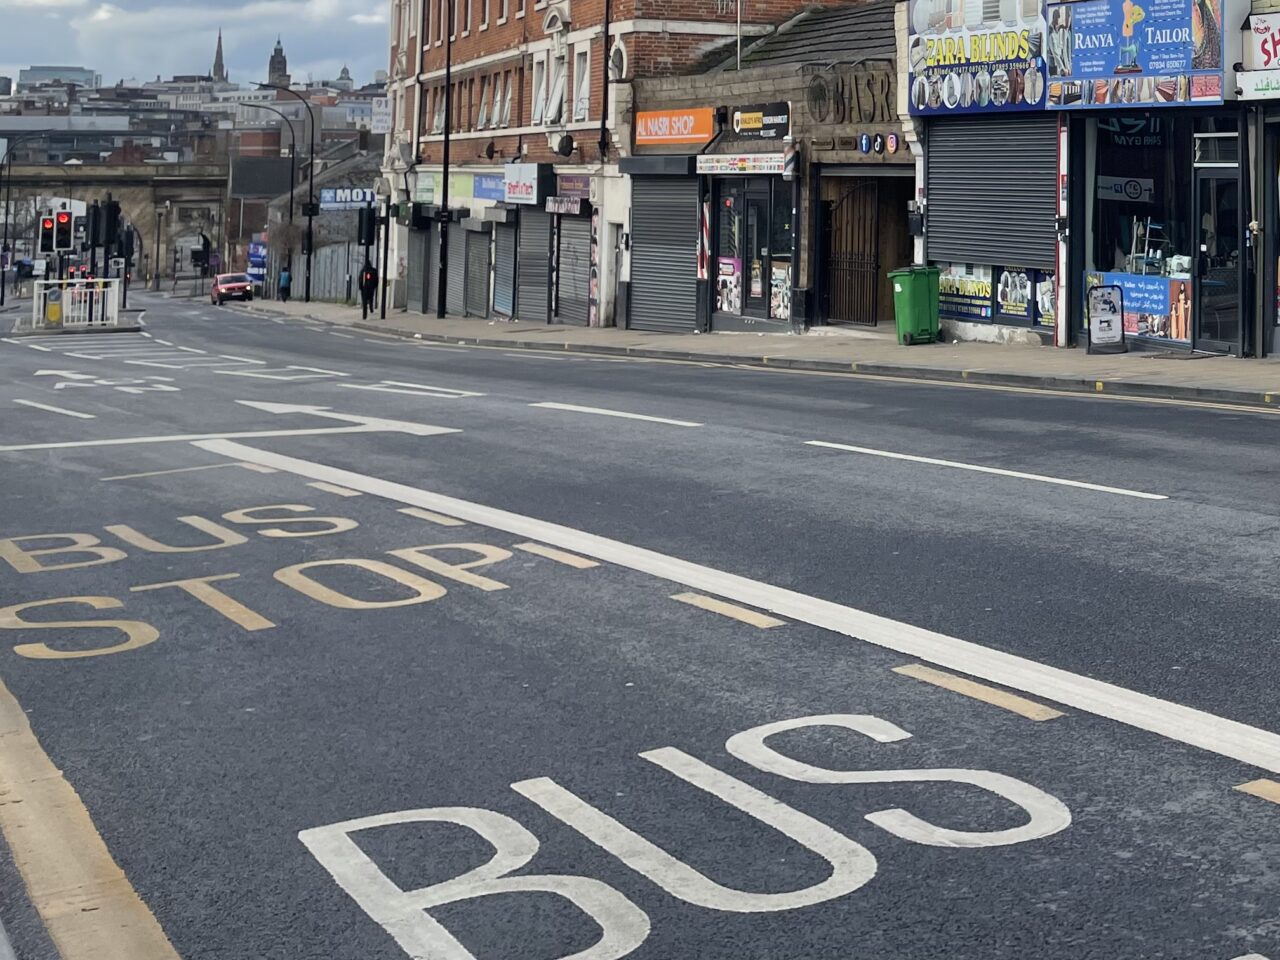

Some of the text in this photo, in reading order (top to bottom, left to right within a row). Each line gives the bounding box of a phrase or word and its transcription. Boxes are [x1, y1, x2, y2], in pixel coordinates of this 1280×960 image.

[927, 30, 1030, 66] ZARA BLINDS
[1074, 26, 1190, 49] RANYA TAILOR
[832, 72, 900, 123] BASR
[636, 118, 646, 136] AL
[672, 115, 695, 135] SHOP
[939, 276, 957, 294] ARA
[0, 504, 360, 573] BUS
[0, 543, 514, 659] STOP
[298, 714, 1071, 960] BUS
